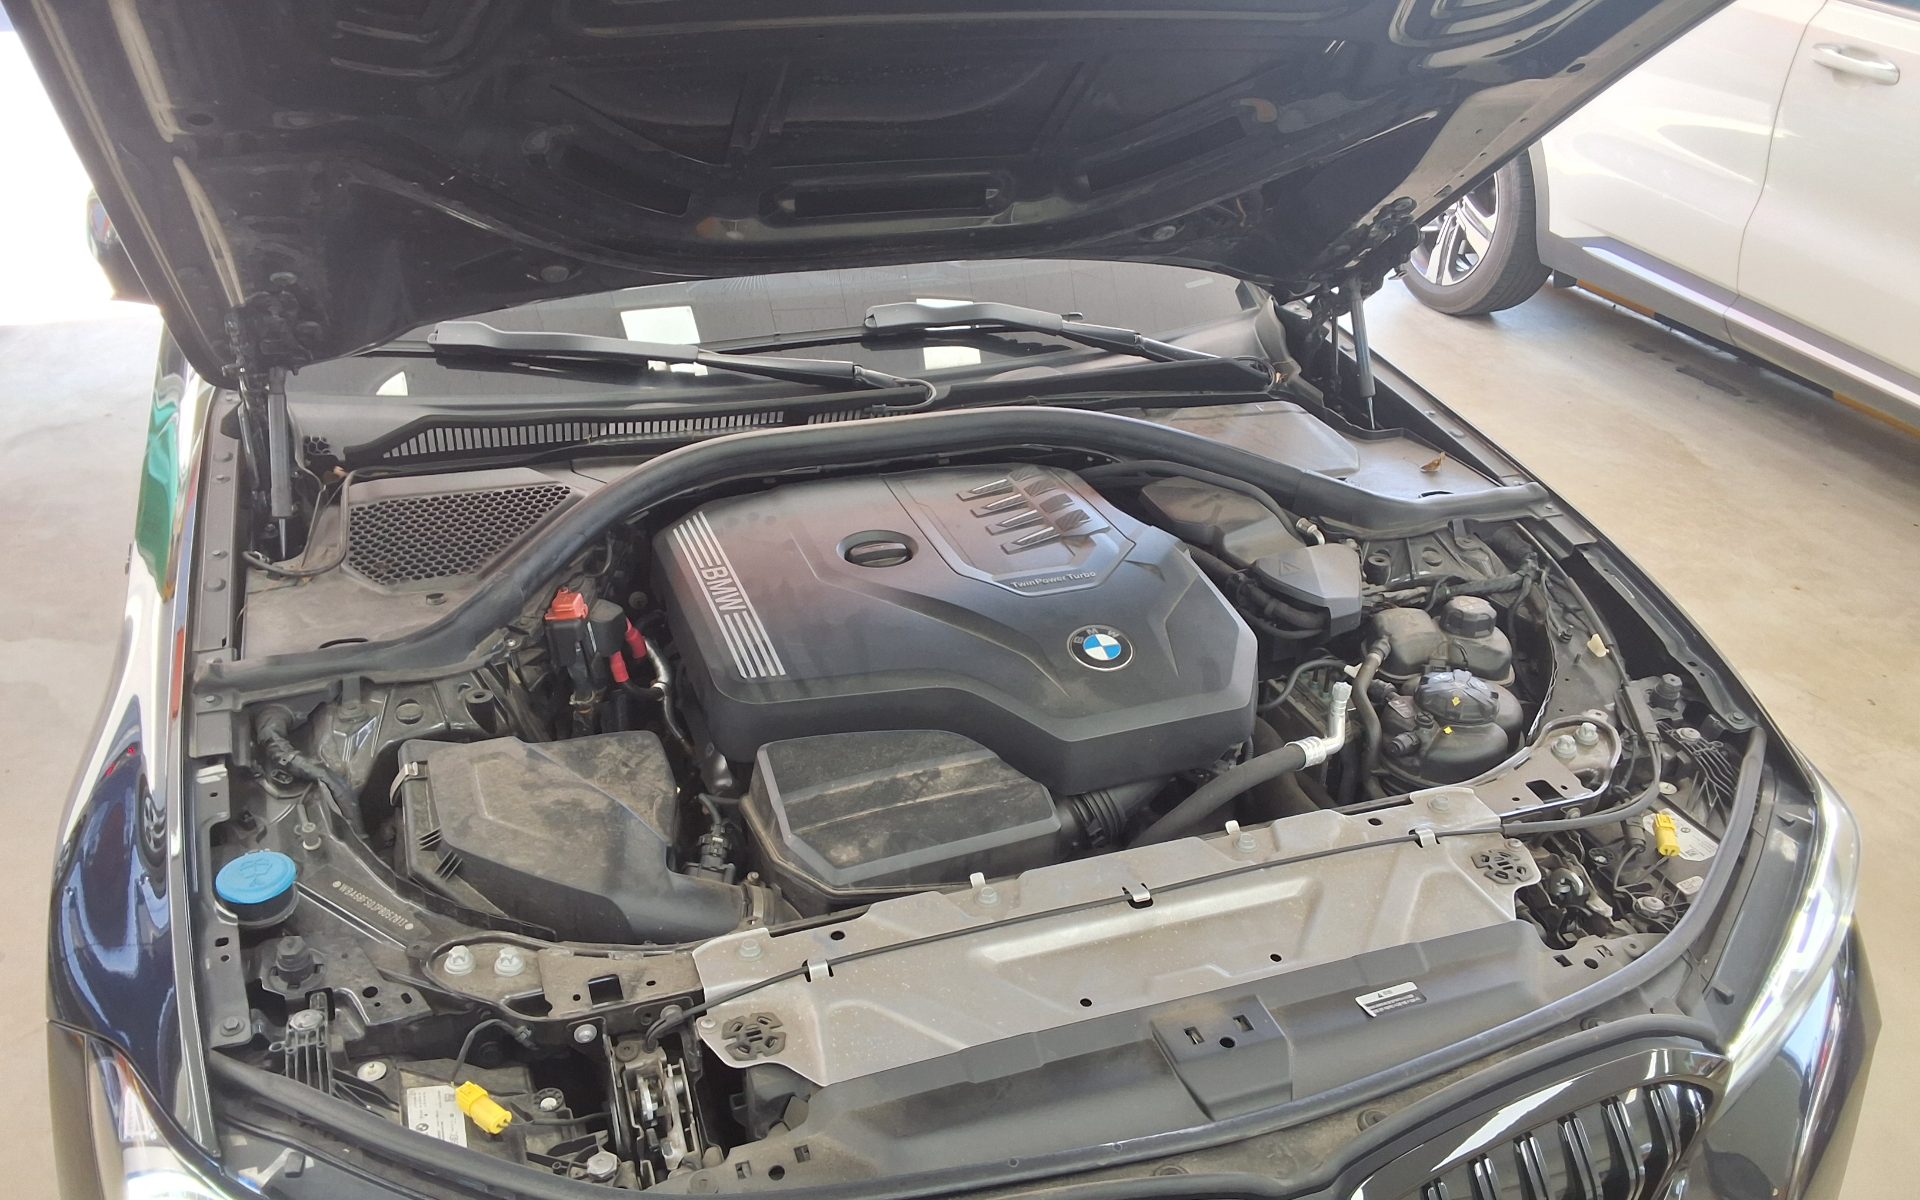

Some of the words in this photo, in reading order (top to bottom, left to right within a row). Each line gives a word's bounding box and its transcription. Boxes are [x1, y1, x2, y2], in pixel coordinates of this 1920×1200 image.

[1010, 575, 1066, 588] TwinPower
[1067, 570, 1097, 581] Turbo
[700, 566, 747, 611] BMW
[1073, 627, 1120, 644] BMW
